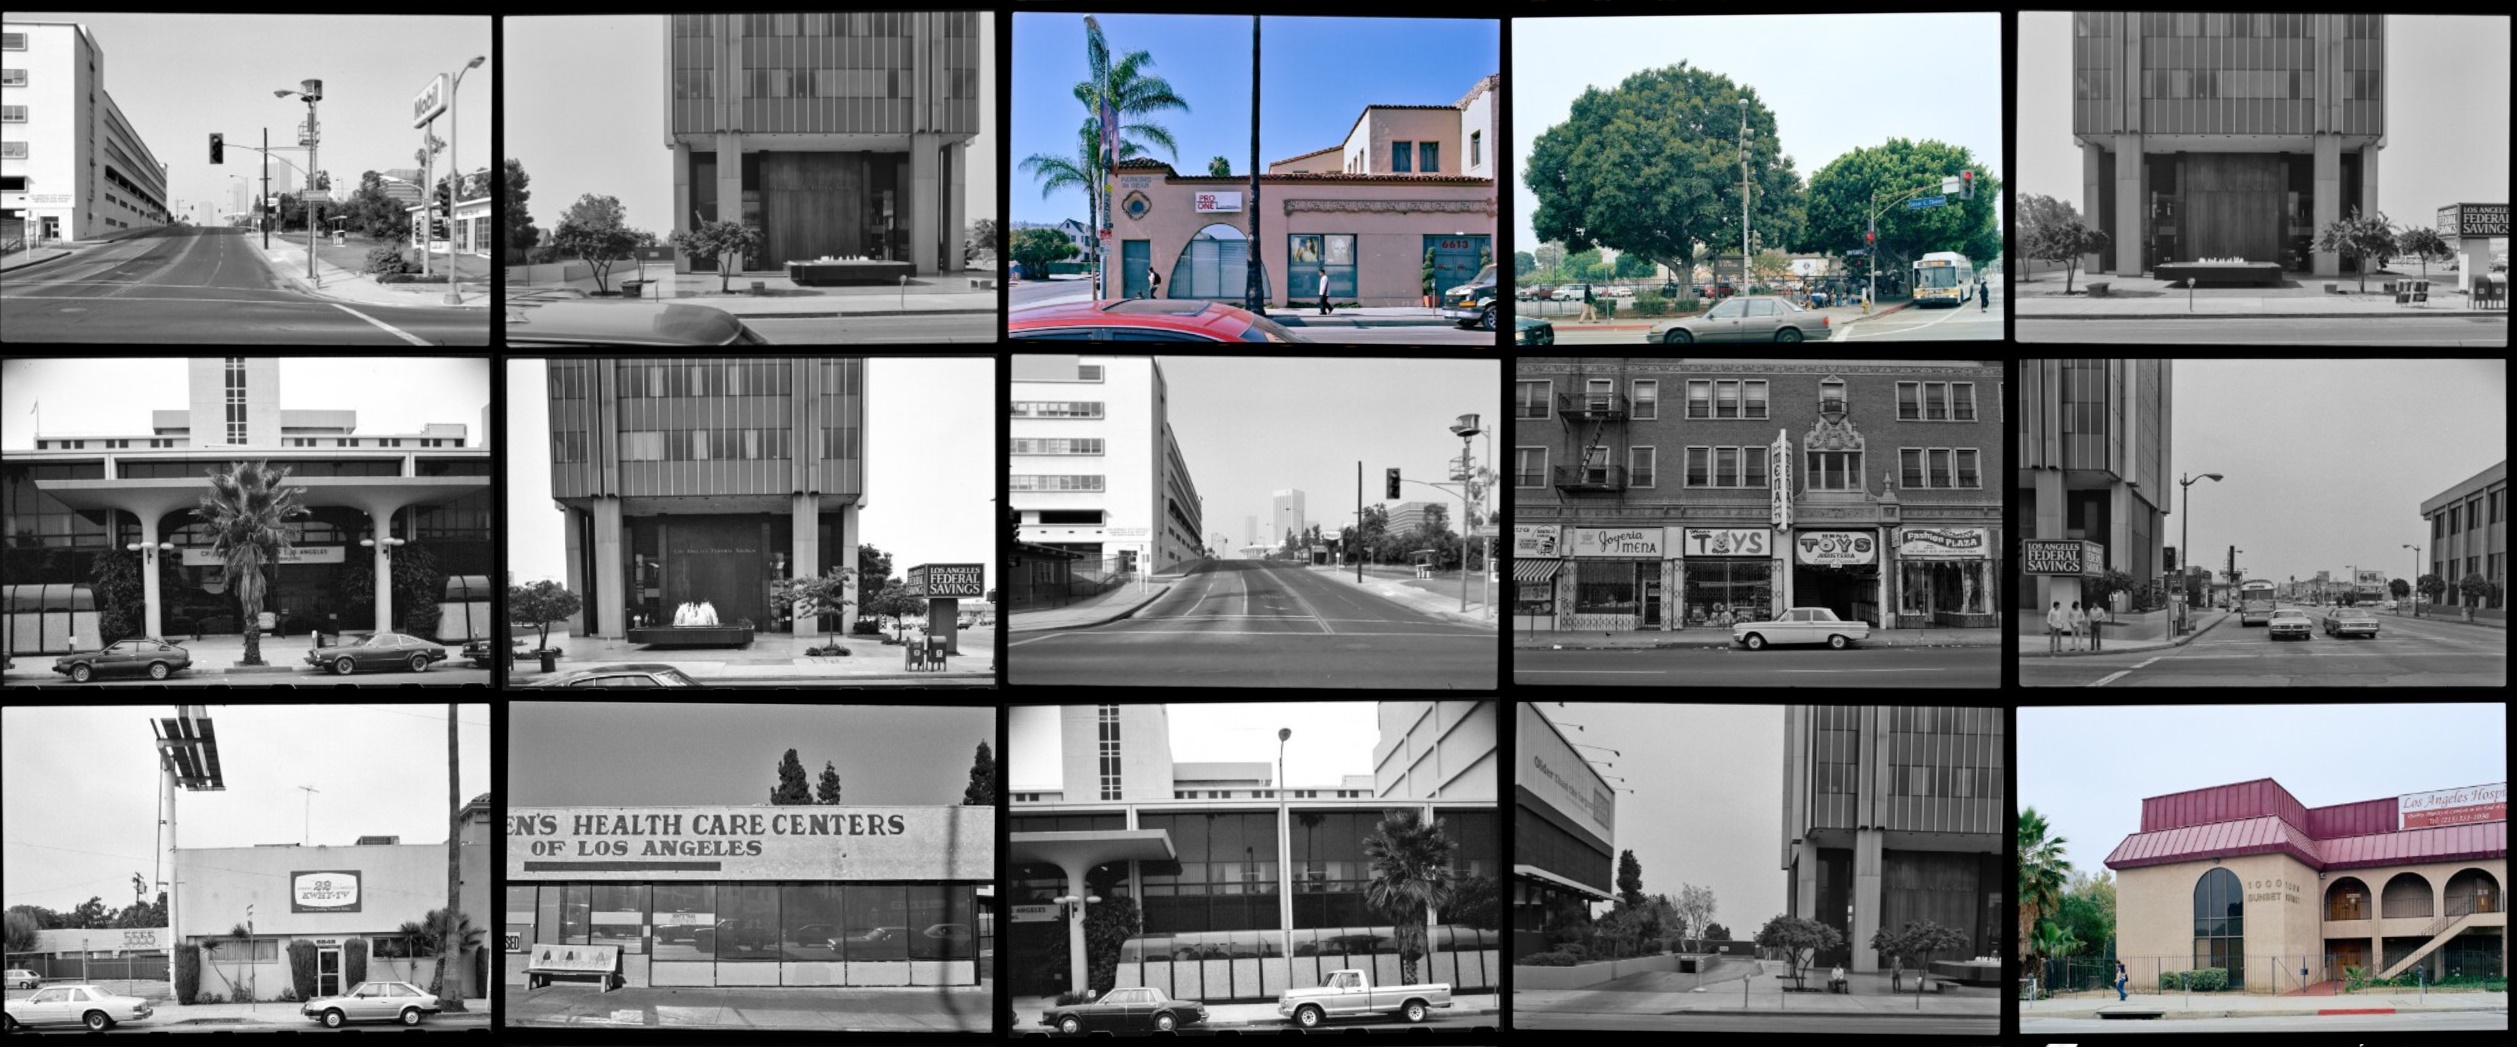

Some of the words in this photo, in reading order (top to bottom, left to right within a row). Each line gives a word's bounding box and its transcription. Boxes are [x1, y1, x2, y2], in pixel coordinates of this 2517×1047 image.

[415, 83, 438, 121] Mobil
[1442, 241, 1469, 249] 6613
[1800, 538, 1871, 553] TOYS
[1907, 531, 1945, 543] Fashion
[1946, 538, 1977, 548] PLAZA
[2043, 543, 2080, 551] ANGELES
[2028, 550, 2080, 561] FEDERAL
[2028, 560, 2080, 572] SAVINGS
[930, 573, 980, 584] FEDERAL
[929, 583, 980, 594] SAVINGS
[2403, 797, 2423, 809] Los
[2424, 790, 2468, 808] Angeles
[573, 814, 683, 836] HEALTH
[692, 814, 766, 836] CARE
[772, 814, 905, 836] CENTERS
[531, 840, 566, 856] OF
[578, 840, 629, 856] LOS
[641, 840, 762, 856] ANGELES
[2248, 879, 2282, 890] 1000
[2248, 892, 2282, 902] SUNSET
[123, 931, 156, 945] 5555
[505, 935, 520, 950] SED
